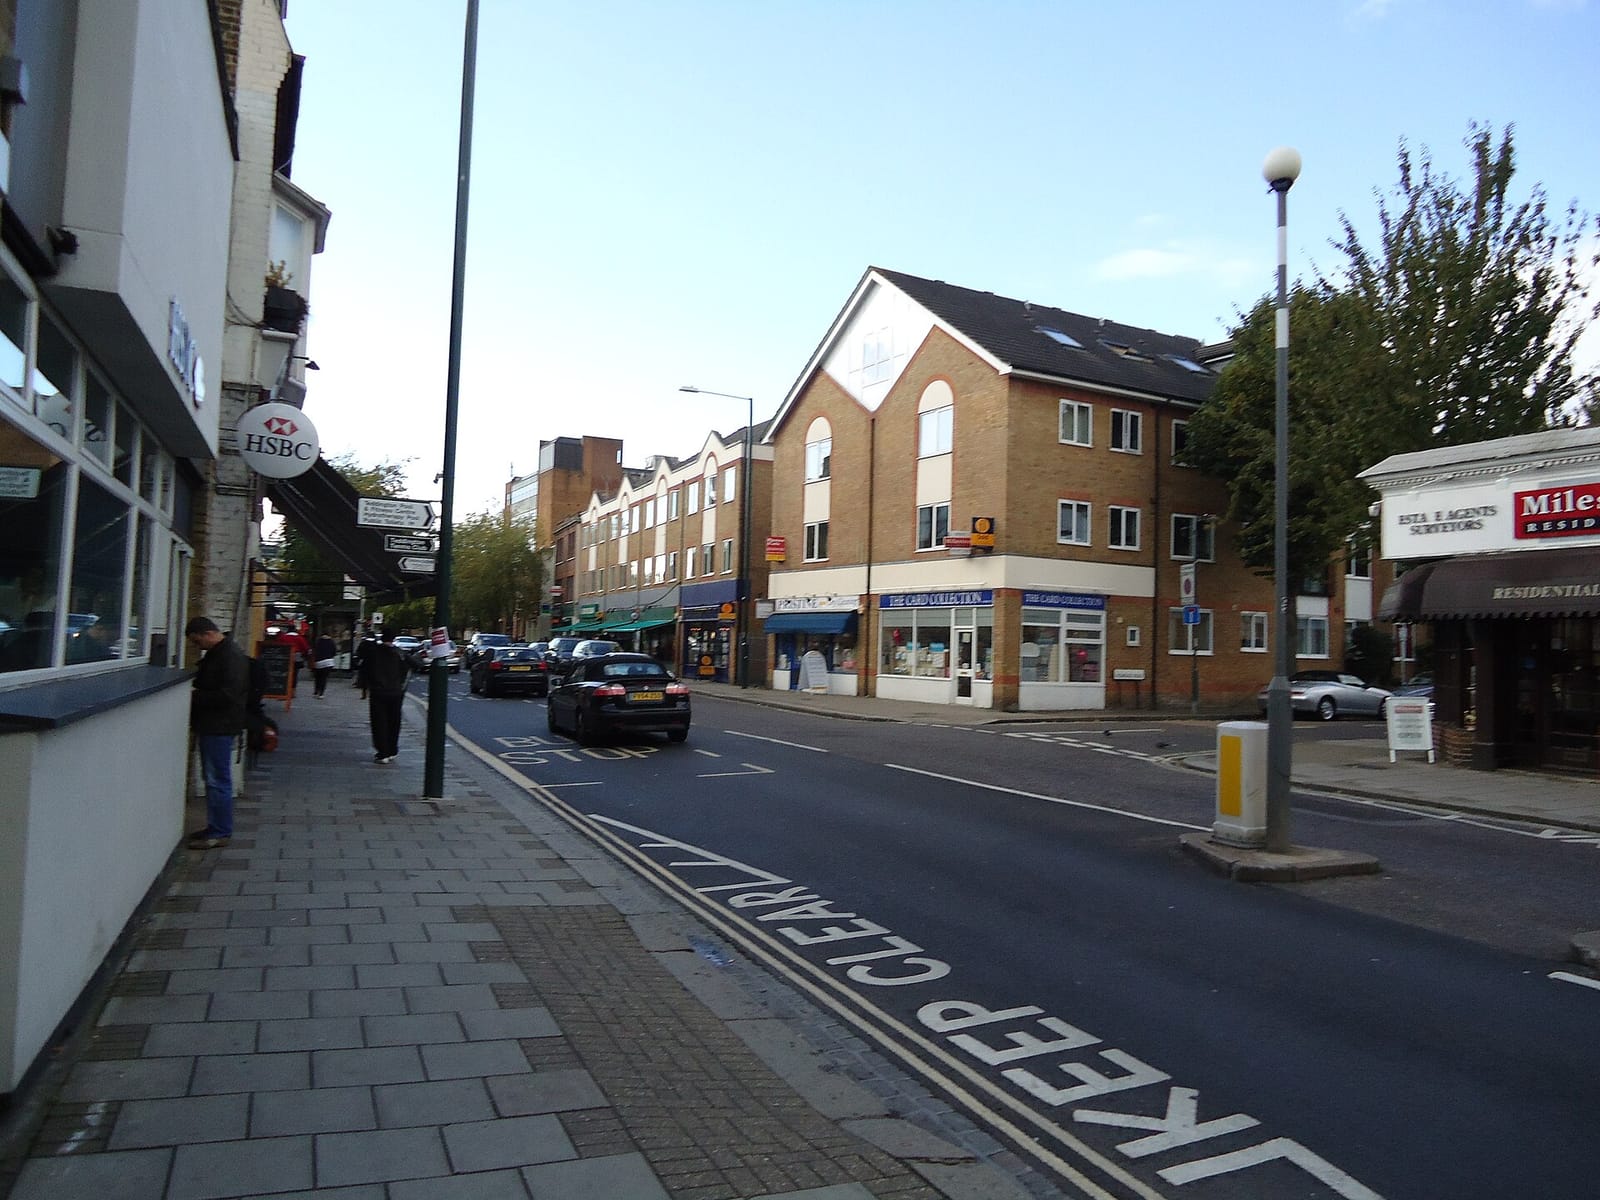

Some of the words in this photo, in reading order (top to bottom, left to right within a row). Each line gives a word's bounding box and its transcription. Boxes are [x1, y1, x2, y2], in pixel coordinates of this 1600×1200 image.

[244, 433, 312, 461] HSBC
[1443, 504, 1498, 521] AGENTS
[1410, 519, 1483, 536] SURVEYORS
[889, 595, 905, 606] THE
[906, 593, 929, 606] CARD
[930, 591, 983, 605] COLLECTION
[1025, 593, 1038, 602] THE
[1040, 594, 1059, 604] CARD
[1060, 595, 1103, 606] COLLECTION
[1493, 583, 1600, 600] RESIDENTIAL
[499, 746, 660, 765] STOP
[727, 886, 952, 987] CLEAR
[916, 1000, 1262, 1159] KEEP
